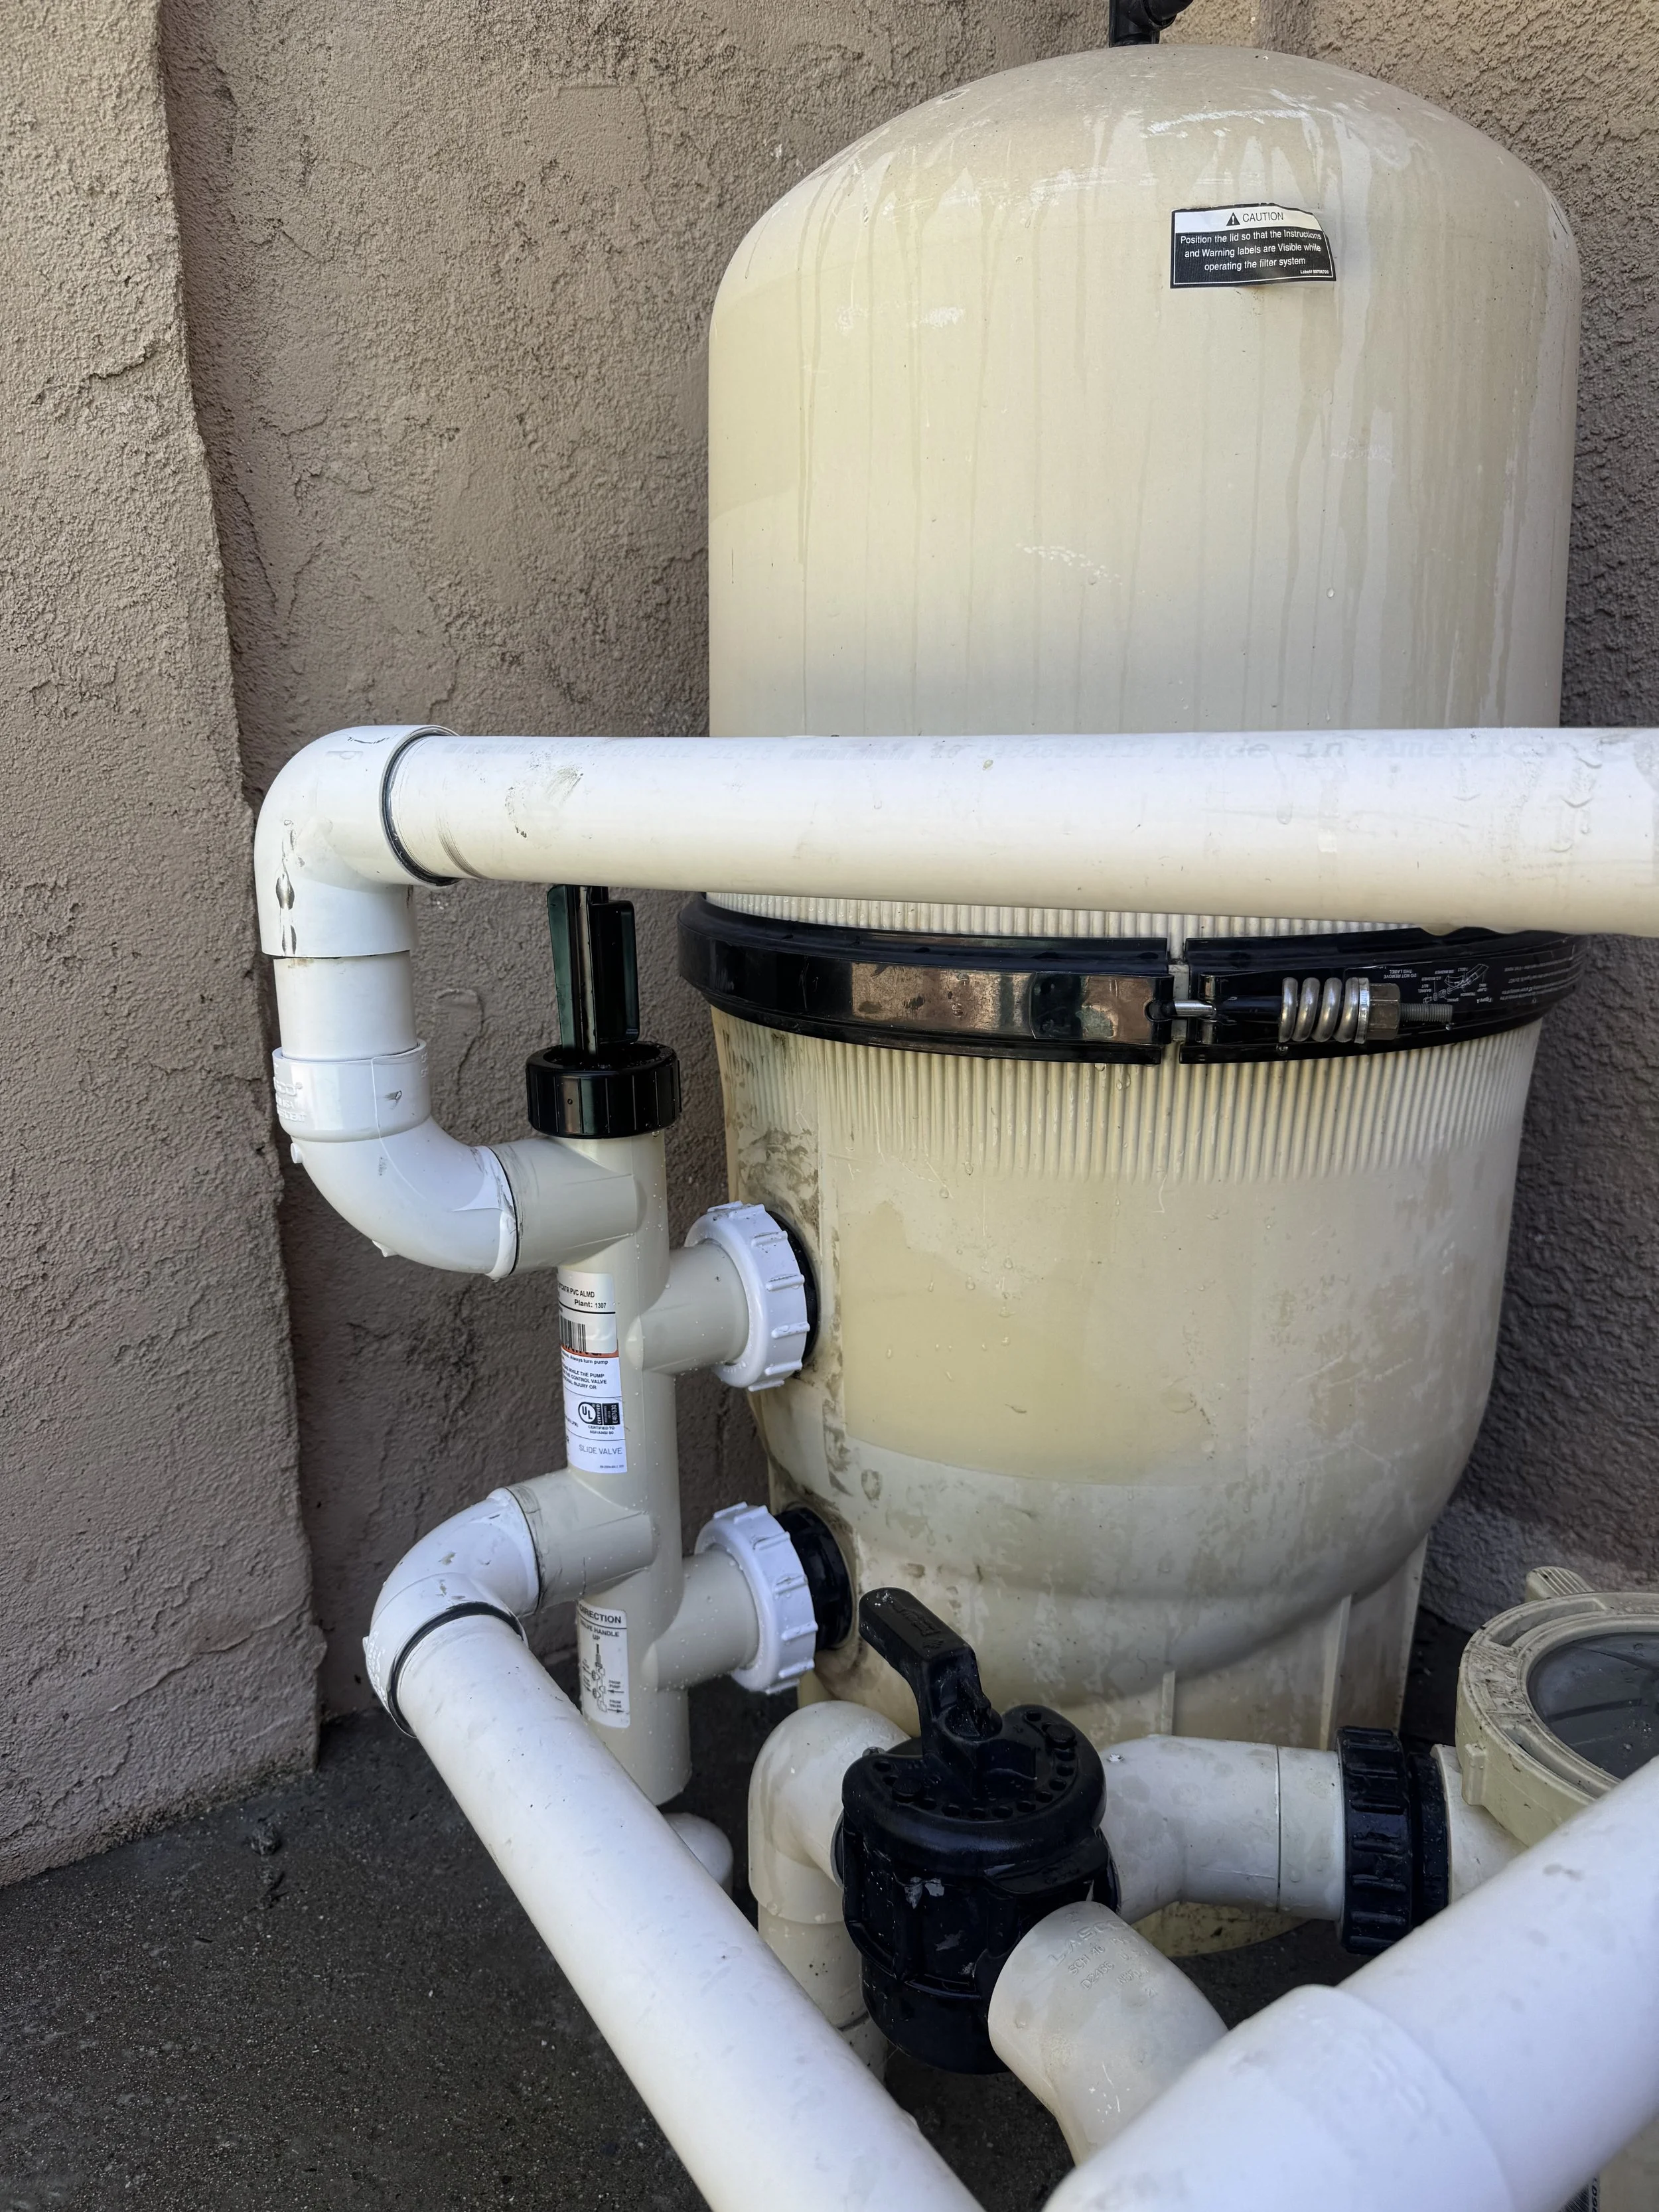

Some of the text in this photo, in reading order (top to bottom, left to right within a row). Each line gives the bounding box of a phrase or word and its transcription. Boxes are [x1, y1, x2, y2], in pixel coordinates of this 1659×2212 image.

[1242, 212, 1284, 222] CAUTION
[1181, 236, 1212, 244] Position
[1230, 233, 1239, 242] lid
[1253, 231, 1268, 240] that
[1269, 230, 1282, 239] the
[1284, 230, 1322, 240] Instructions
[1185, 249, 1200, 258] and
[1202, 248, 1235, 258] Warning
[1237, 246, 1261, 256] labels
[1277, 243, 1302, 252] Visible
[1303, 243, 1321, 252] while
[1204, 257, 1305, 272] operating the filter system
[574, 1299, 593, 1307] Plant:
[571, 1374, 590, 1383] CONTROL
[582, 1406, 593, 1420] UL
[579, 1444, 597, 1454] SLIDE
[594, 1627, 620, 1637] HANDLE
[1046, 1919, 1128, 1967] LASCO
[1068, 1954, 1090, 1976] SCH
[1080, 1960, 1115, 1990] D2466
